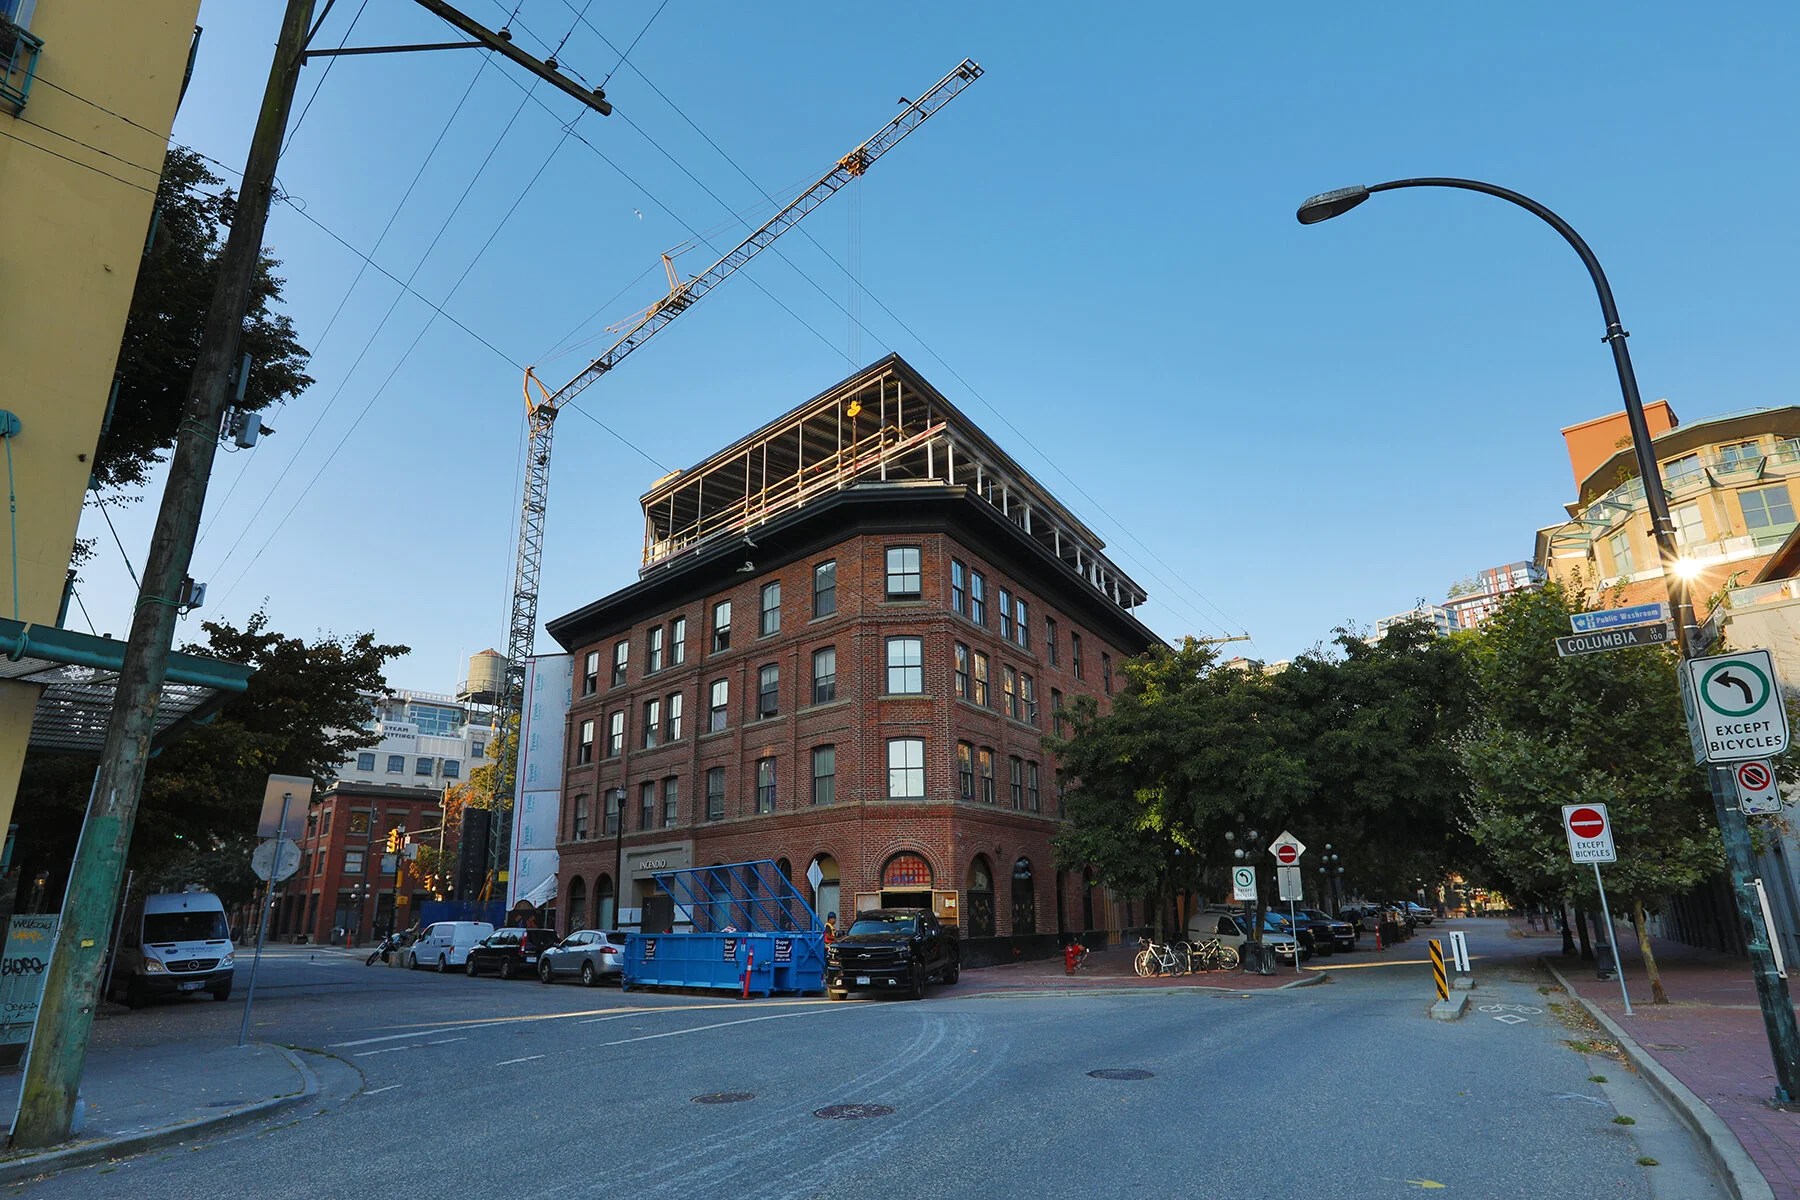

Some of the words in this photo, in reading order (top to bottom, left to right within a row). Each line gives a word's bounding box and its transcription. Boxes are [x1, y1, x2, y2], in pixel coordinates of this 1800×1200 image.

[1596, 614, 1618, 625] Public
[1620, 609, 1659, 620] Washroom
[1567, 631, 1638, 652] COLUMBIA
[1715, 721, 1771, 736] EXCEPT
[1711, 735, 1783, 751] BICYCLES
[1577, 841, 1605, 849] EXCEPT
[640, 859, 666, 869] INCENDIO
